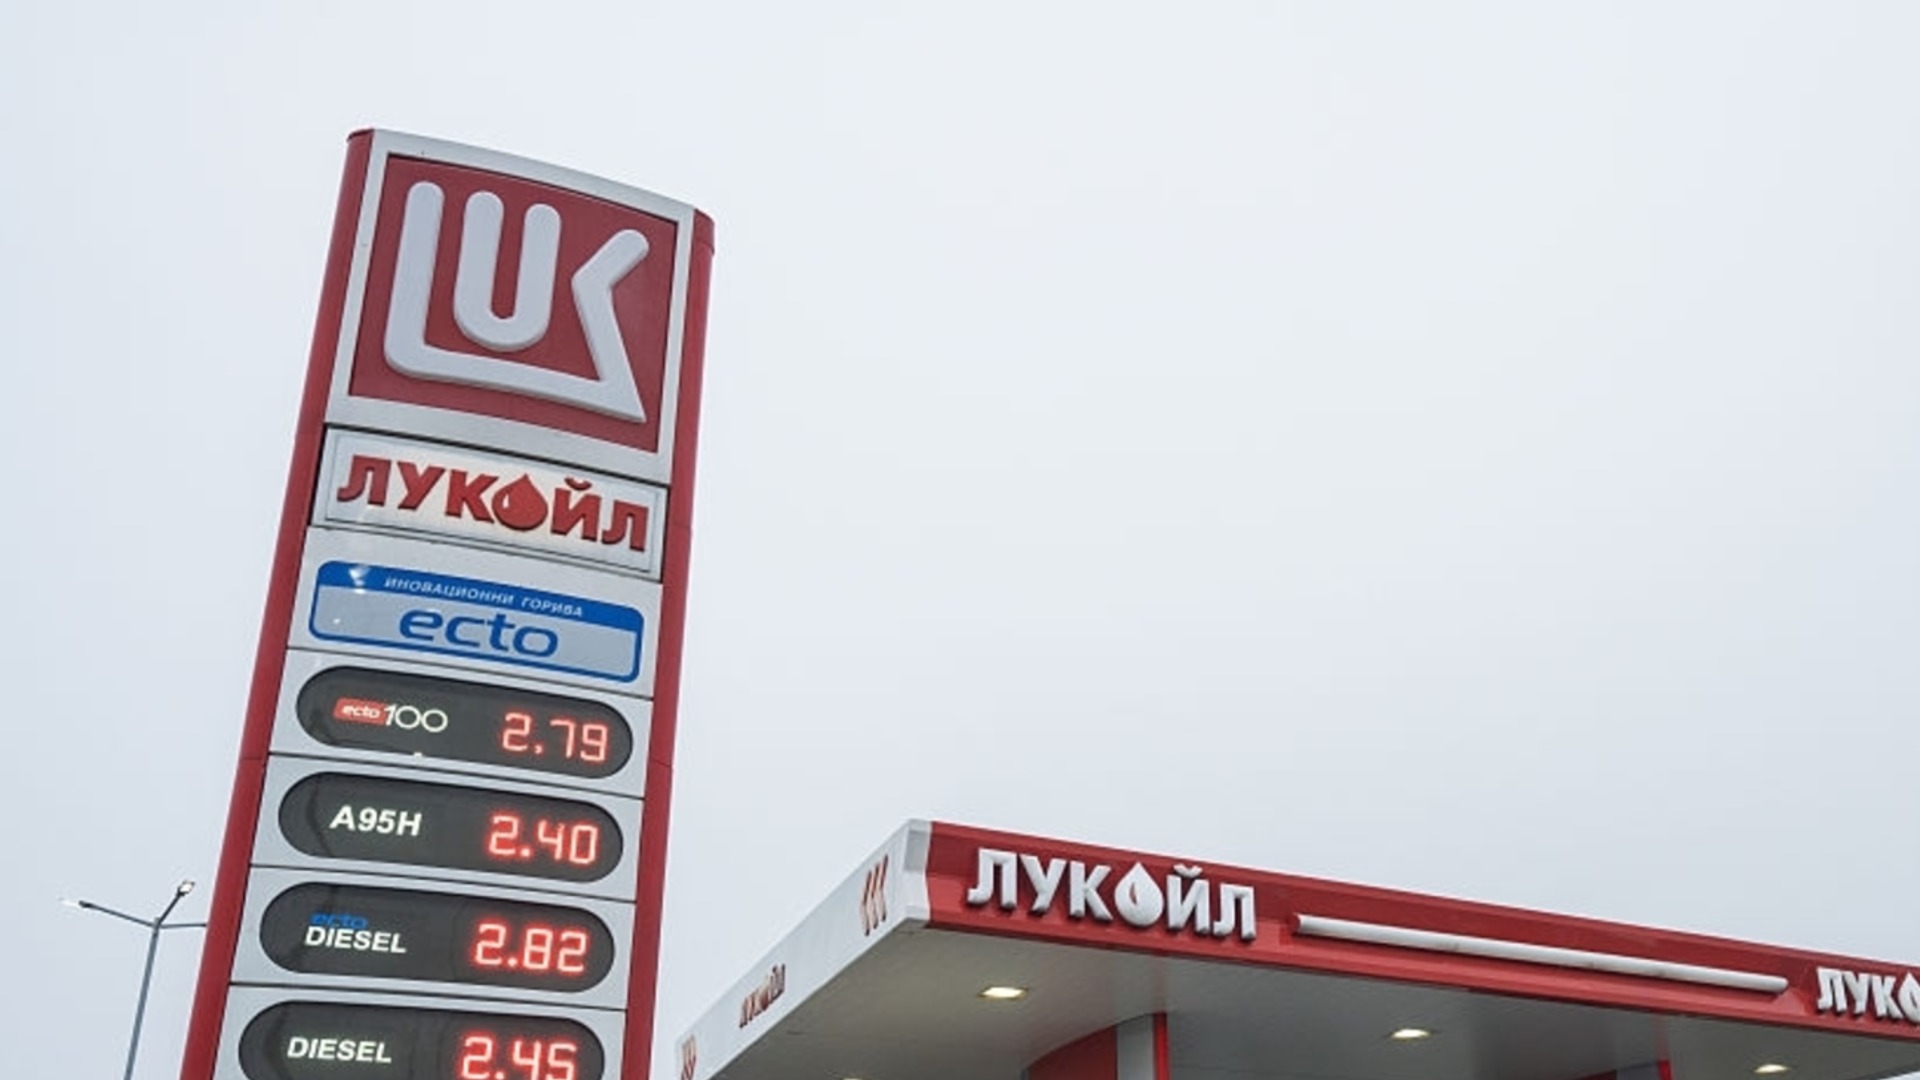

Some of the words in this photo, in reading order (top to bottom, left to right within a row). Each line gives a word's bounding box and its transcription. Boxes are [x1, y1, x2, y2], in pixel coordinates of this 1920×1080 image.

[337, 454, 650, 552] ЛУКОЙЛ
[384, 576, 514, 604] ИНОВАЦИОННИ
[399, 609, 559, 658] ecto
[488, 813, 599, 865] 2.40
[967, 847, 1257, 940] ЛУКОЙЛ
[304, 925, 408, 954] DIESEL
[474, 921, 589, 974] 2.82
[286, 1036, 393, 1064] DIESEL
[461, 1035, 579, 1080] 2.45
